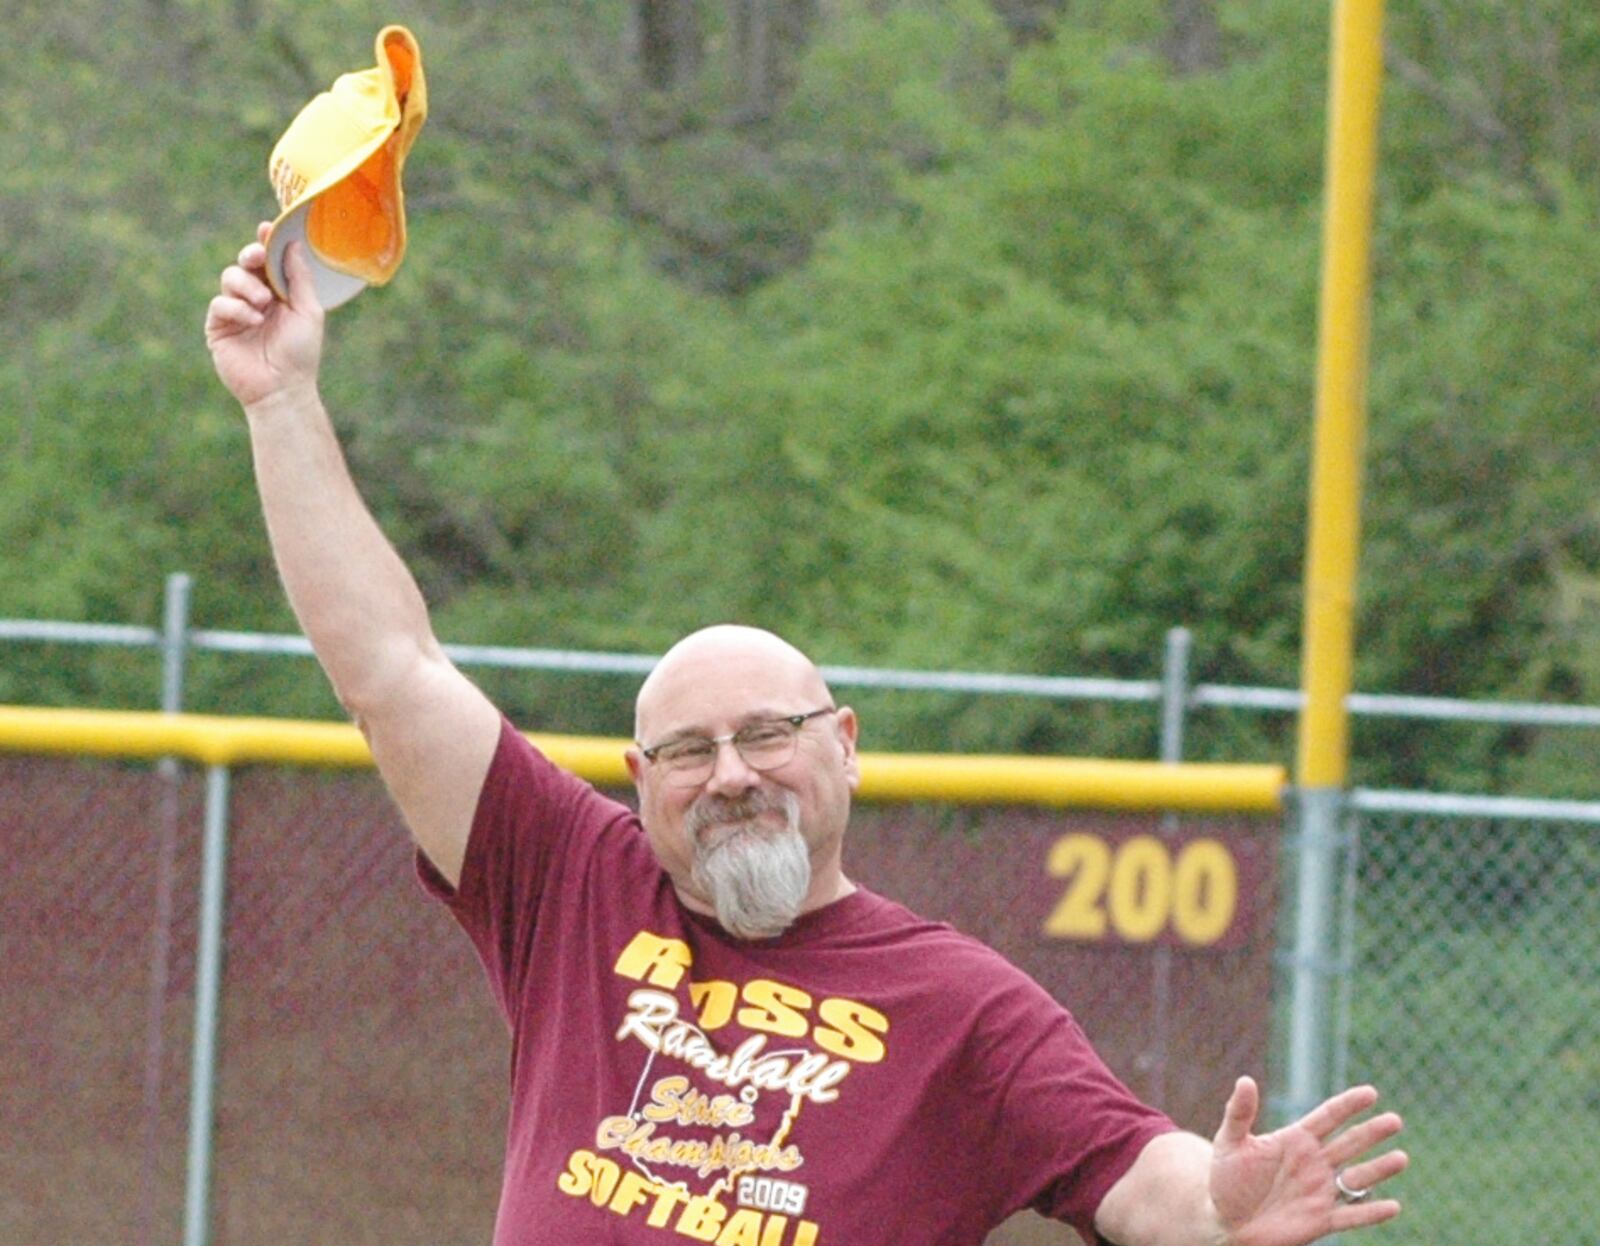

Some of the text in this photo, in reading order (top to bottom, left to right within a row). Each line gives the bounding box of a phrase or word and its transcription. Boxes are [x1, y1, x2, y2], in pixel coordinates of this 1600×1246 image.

[1046, 832, 1236, 944] 200
[596, 1115, 804, 1178] Champions
[737, 1177, 807, 1215] 2009
